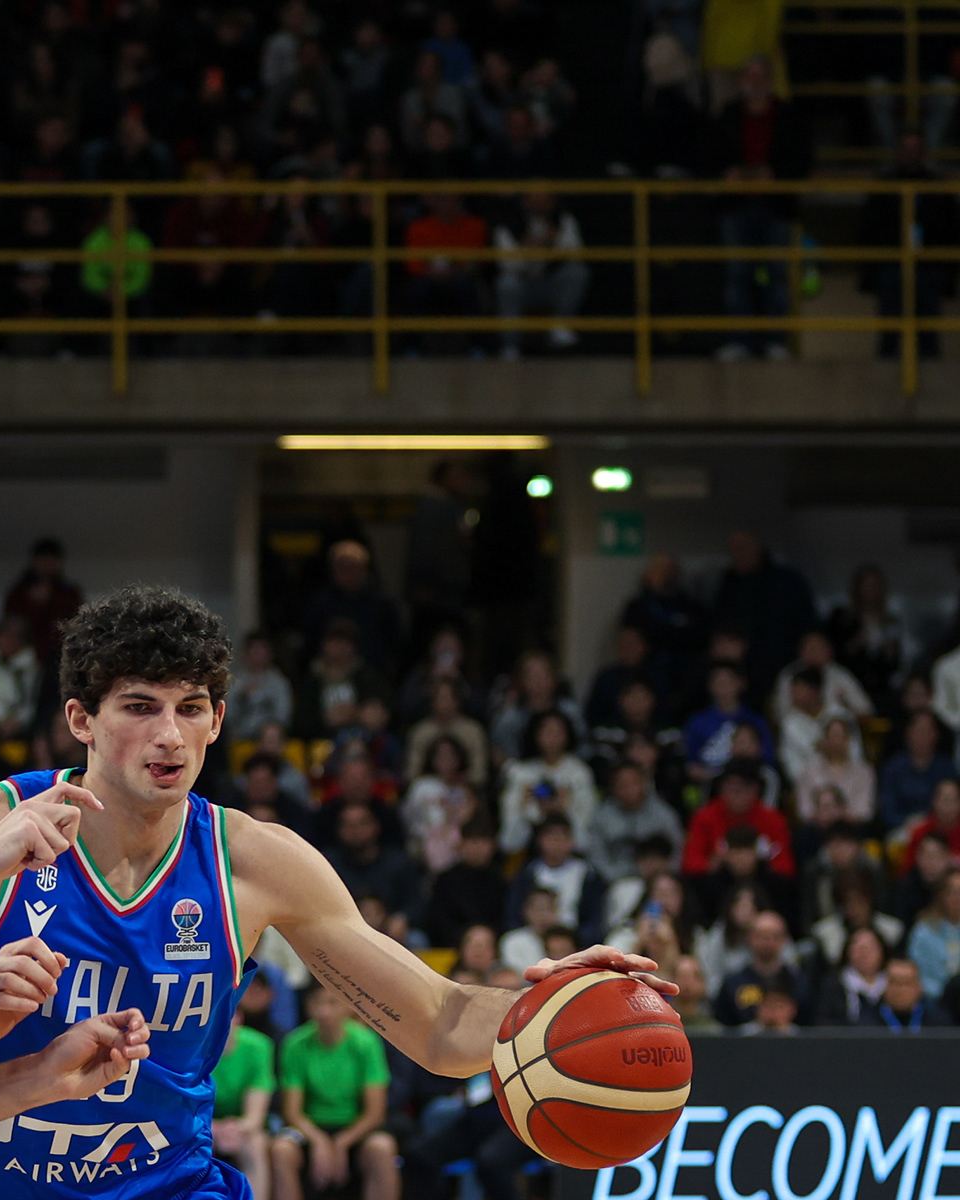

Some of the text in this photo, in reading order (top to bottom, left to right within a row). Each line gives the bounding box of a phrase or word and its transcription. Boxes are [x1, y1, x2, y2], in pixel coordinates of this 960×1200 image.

[166, 944, 209, 953] EUROBASKET
[41, 958, 213, 1032] ALIA
[622, 1046, 686, 1067] molten
